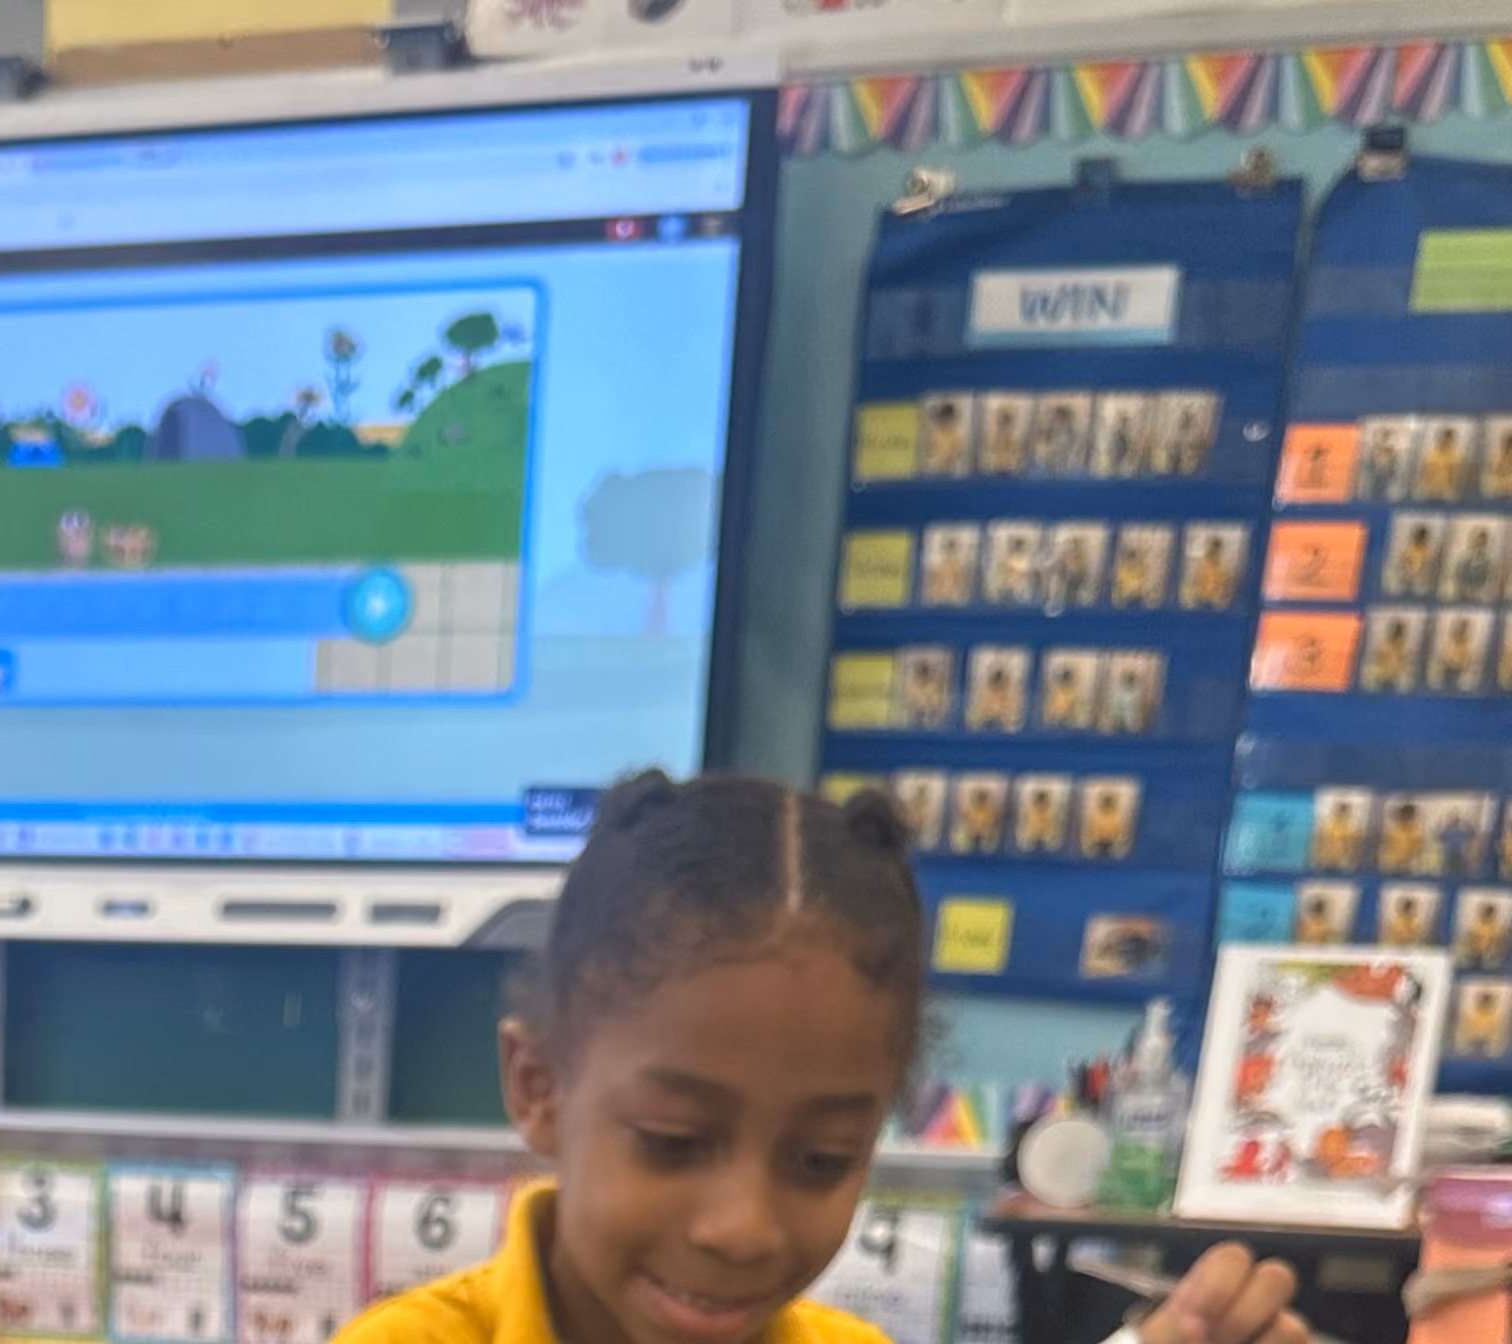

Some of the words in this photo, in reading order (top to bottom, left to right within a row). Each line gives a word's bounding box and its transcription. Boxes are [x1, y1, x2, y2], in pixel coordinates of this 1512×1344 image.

[16, 1165, 58, 1234] 3
[146, 1183, 188, 1234] 4
[279, 1184, 321, 1246] 5
[414, 1191, 458, 1252] 6
